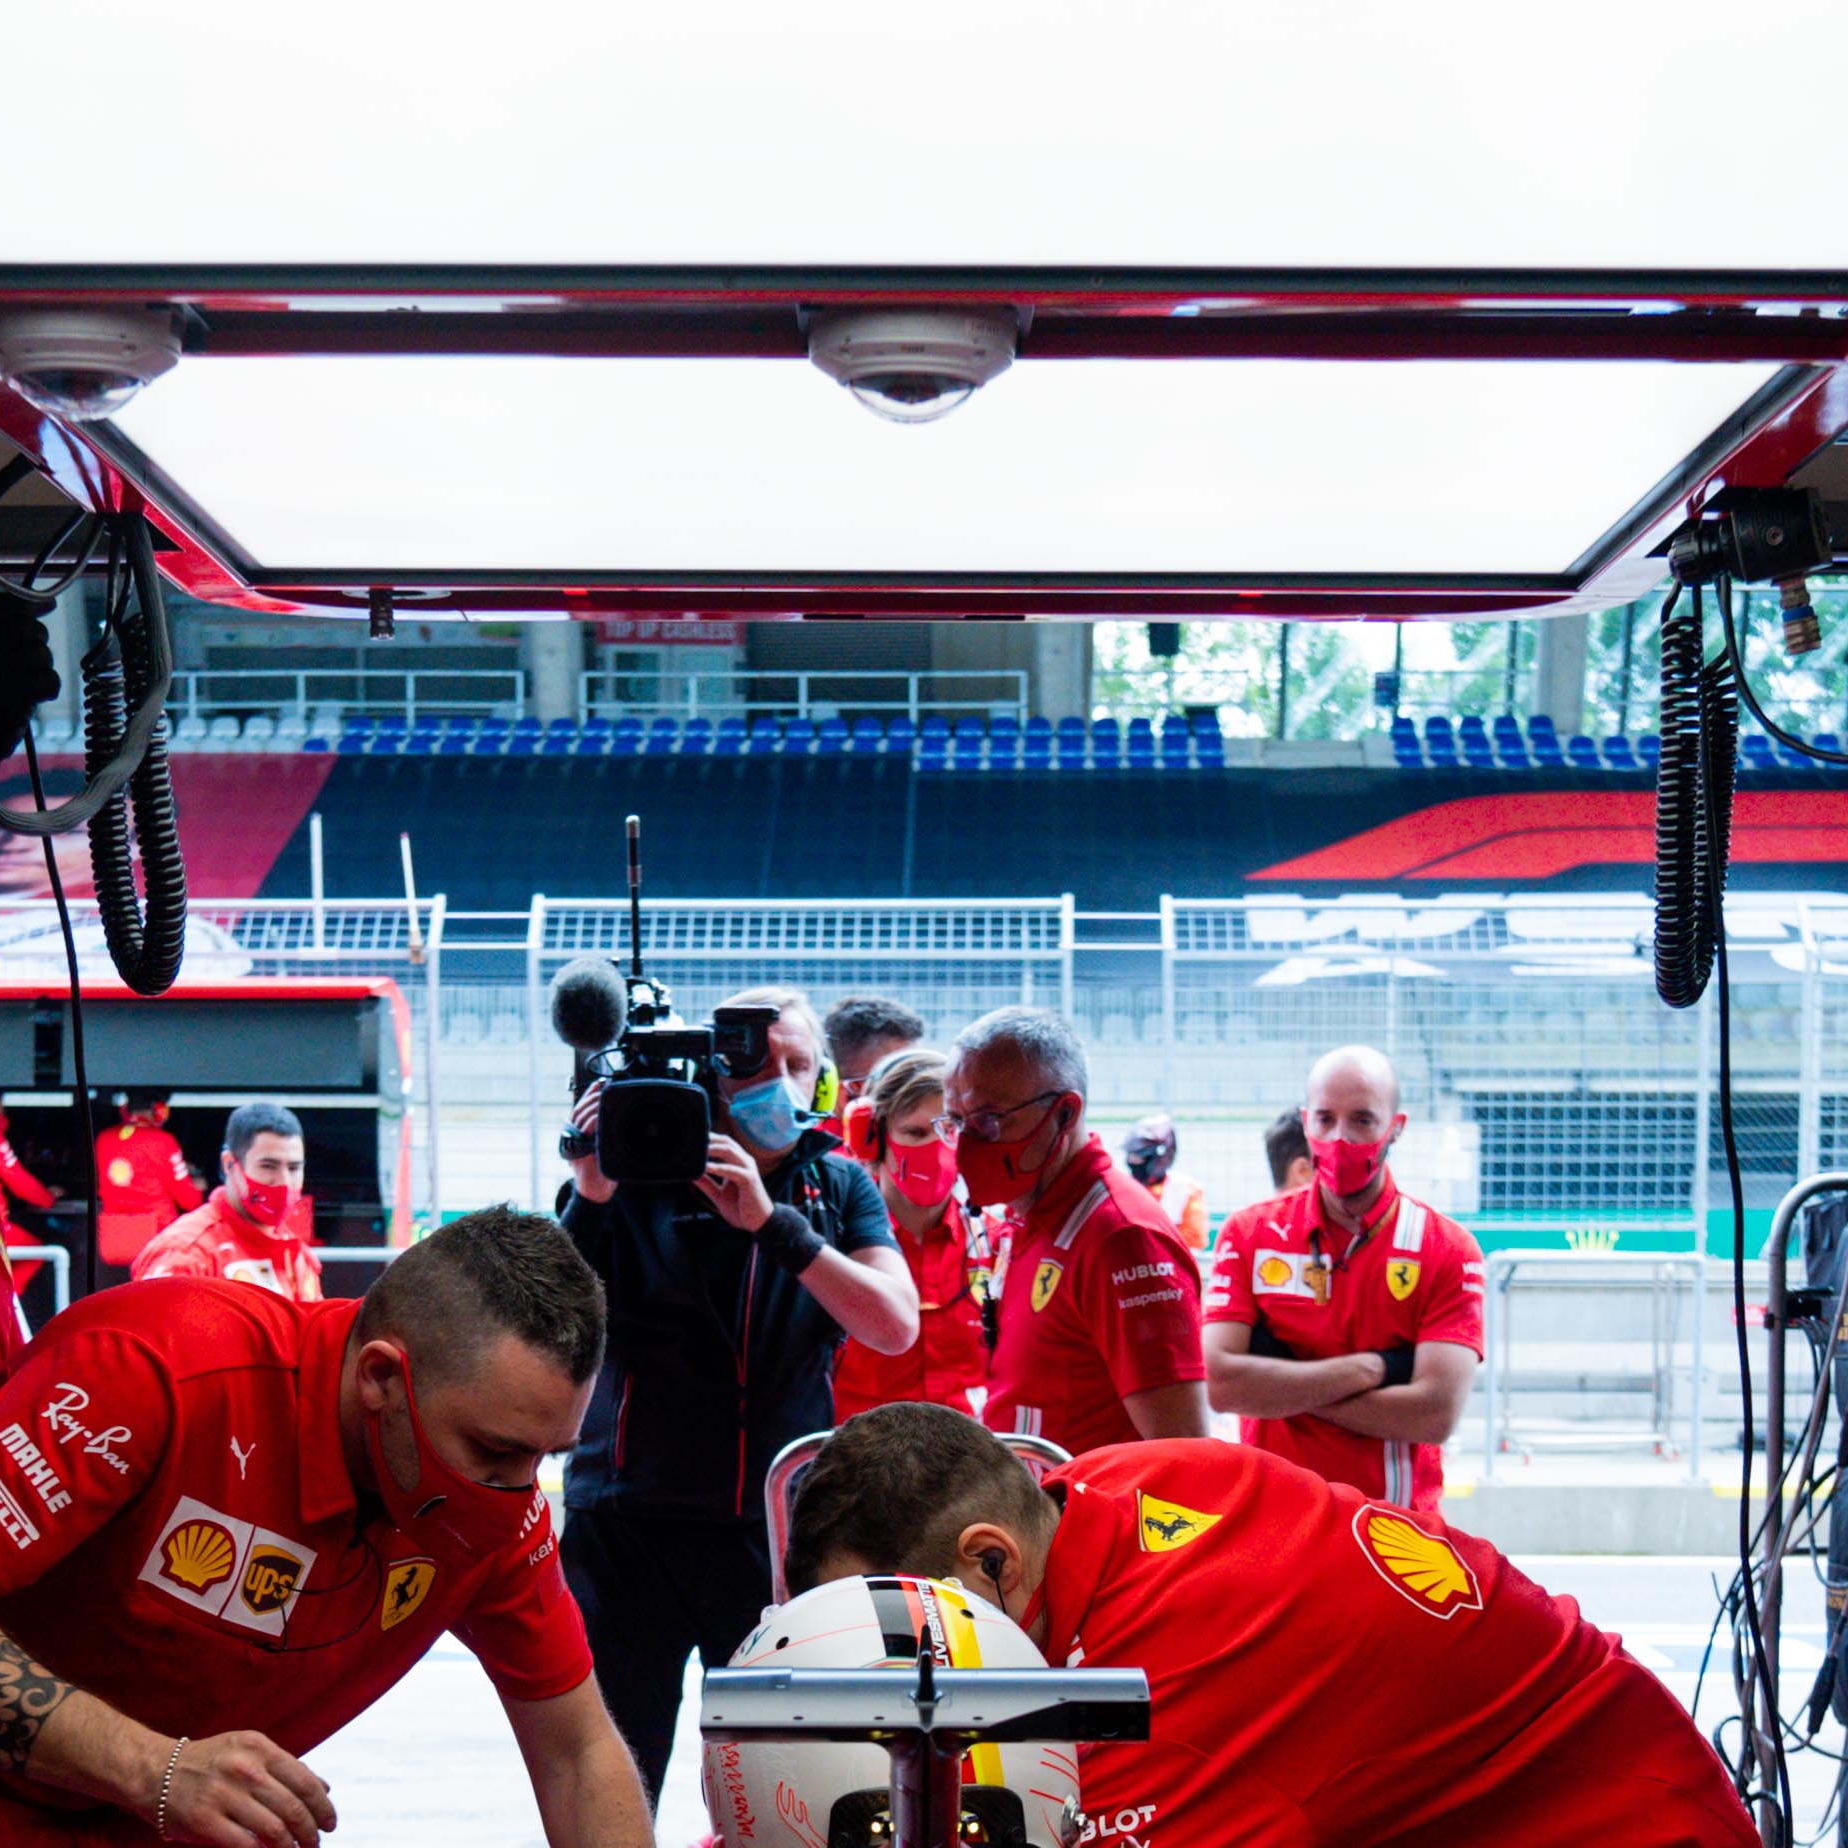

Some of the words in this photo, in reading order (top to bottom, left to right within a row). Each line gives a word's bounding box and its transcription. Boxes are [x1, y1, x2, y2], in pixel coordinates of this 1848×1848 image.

[1111, 1261, 1175, 1285] HUBLOT
[1117, 1287, 1184, 1310] kaspersky
[41, 1382, 132, 1475] Ray-Ban
[250, 1560, 295, 1605] ups
